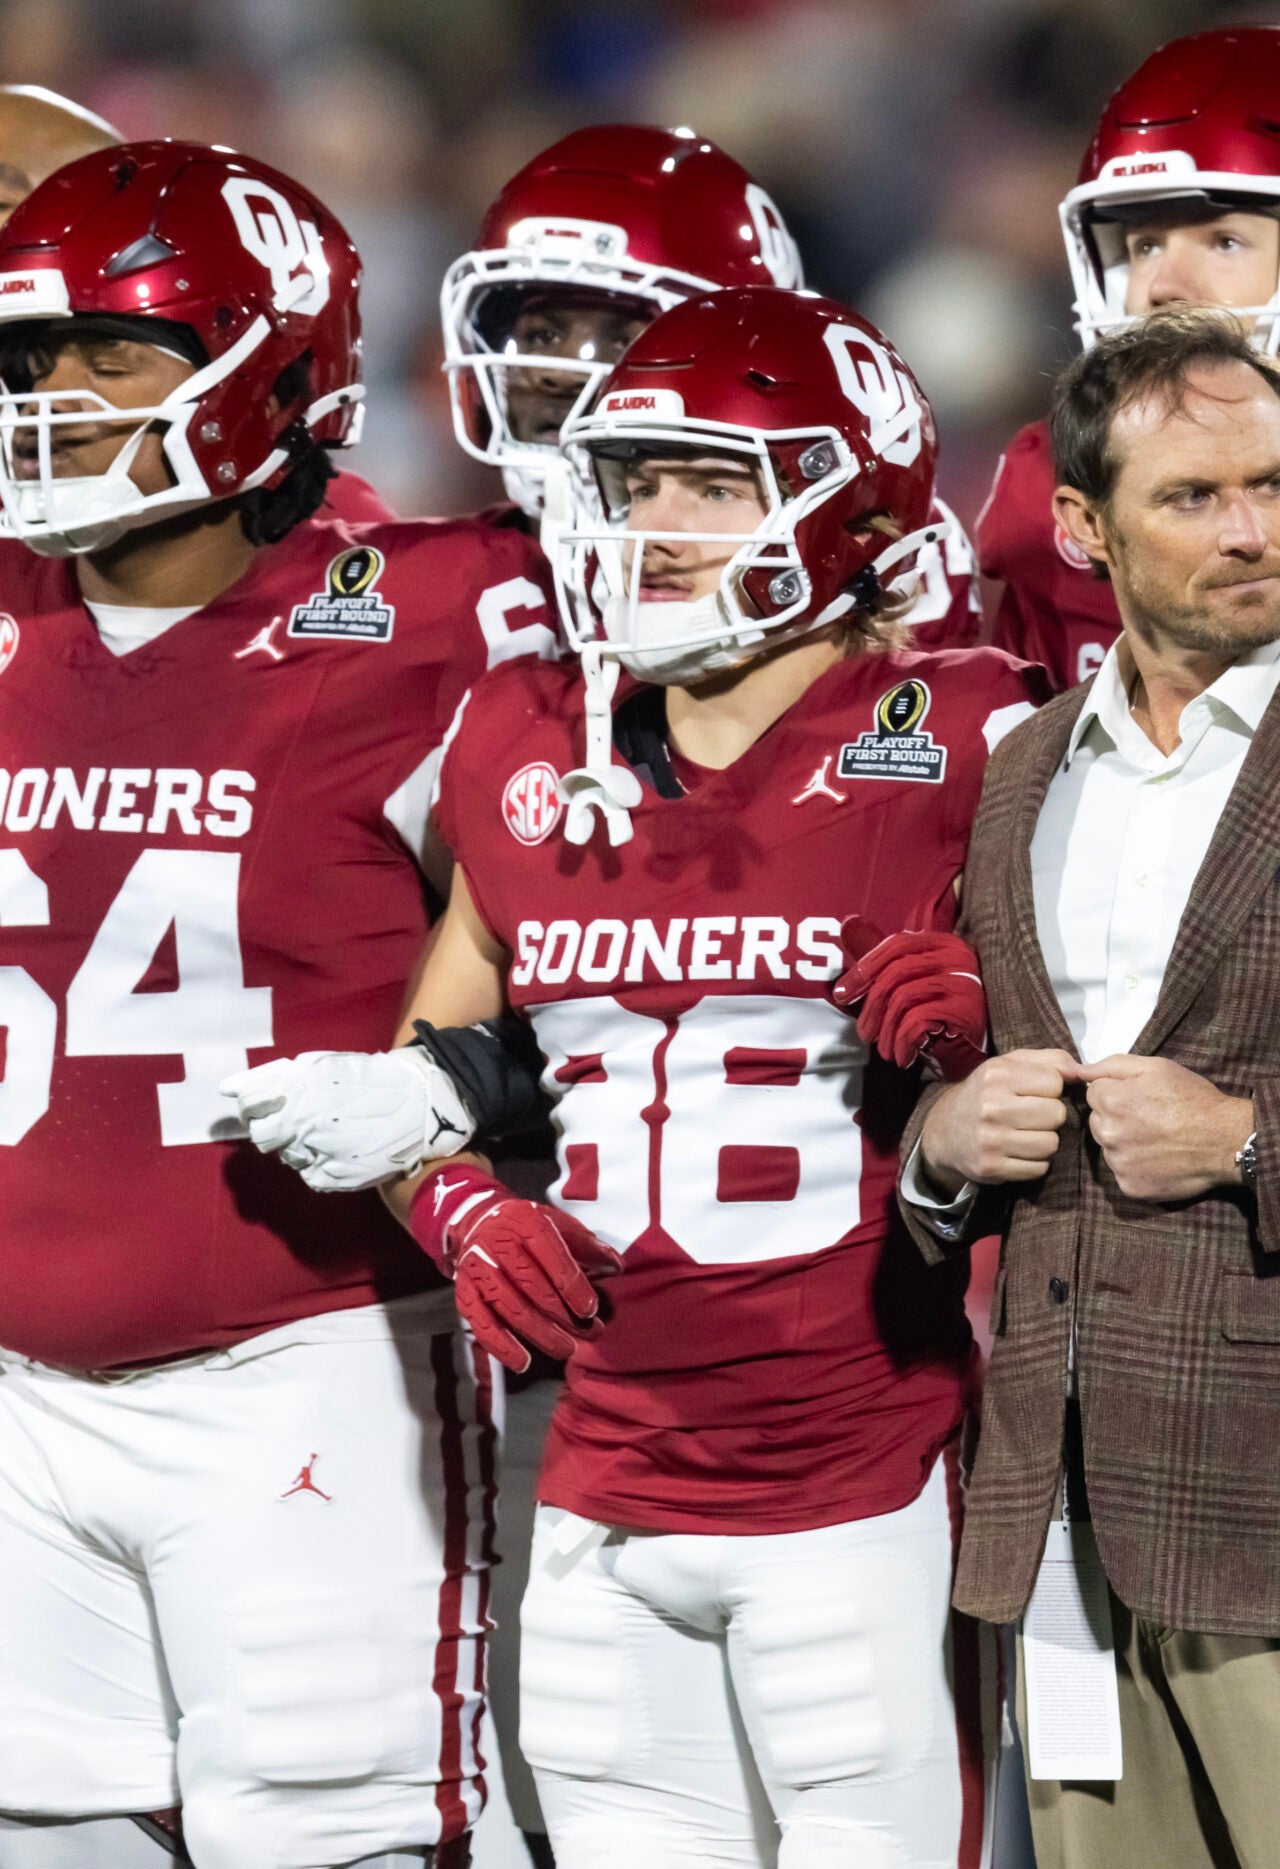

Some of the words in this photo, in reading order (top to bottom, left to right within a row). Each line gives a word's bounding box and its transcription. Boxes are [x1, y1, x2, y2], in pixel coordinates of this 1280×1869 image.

[221, 177, 330, 316] OU
[822, 323, 921, 467] OU
[297, 609, 340, 621] FIRST
[339, 610, 388, 623] ROUND
[314, 597, 376, 609] PLAYOFF
[846, 748, 888, 760] FIRST
[890, 750, 940, 763] ROUND
[863, 737, 926, 749] PLAYOFF
[0, 767, 257, 838] ONERS
[508, 769, 556, 838] SEC
[512, 917, 844, 986] SOONERS
[524, 995, 870, 1265] 88
